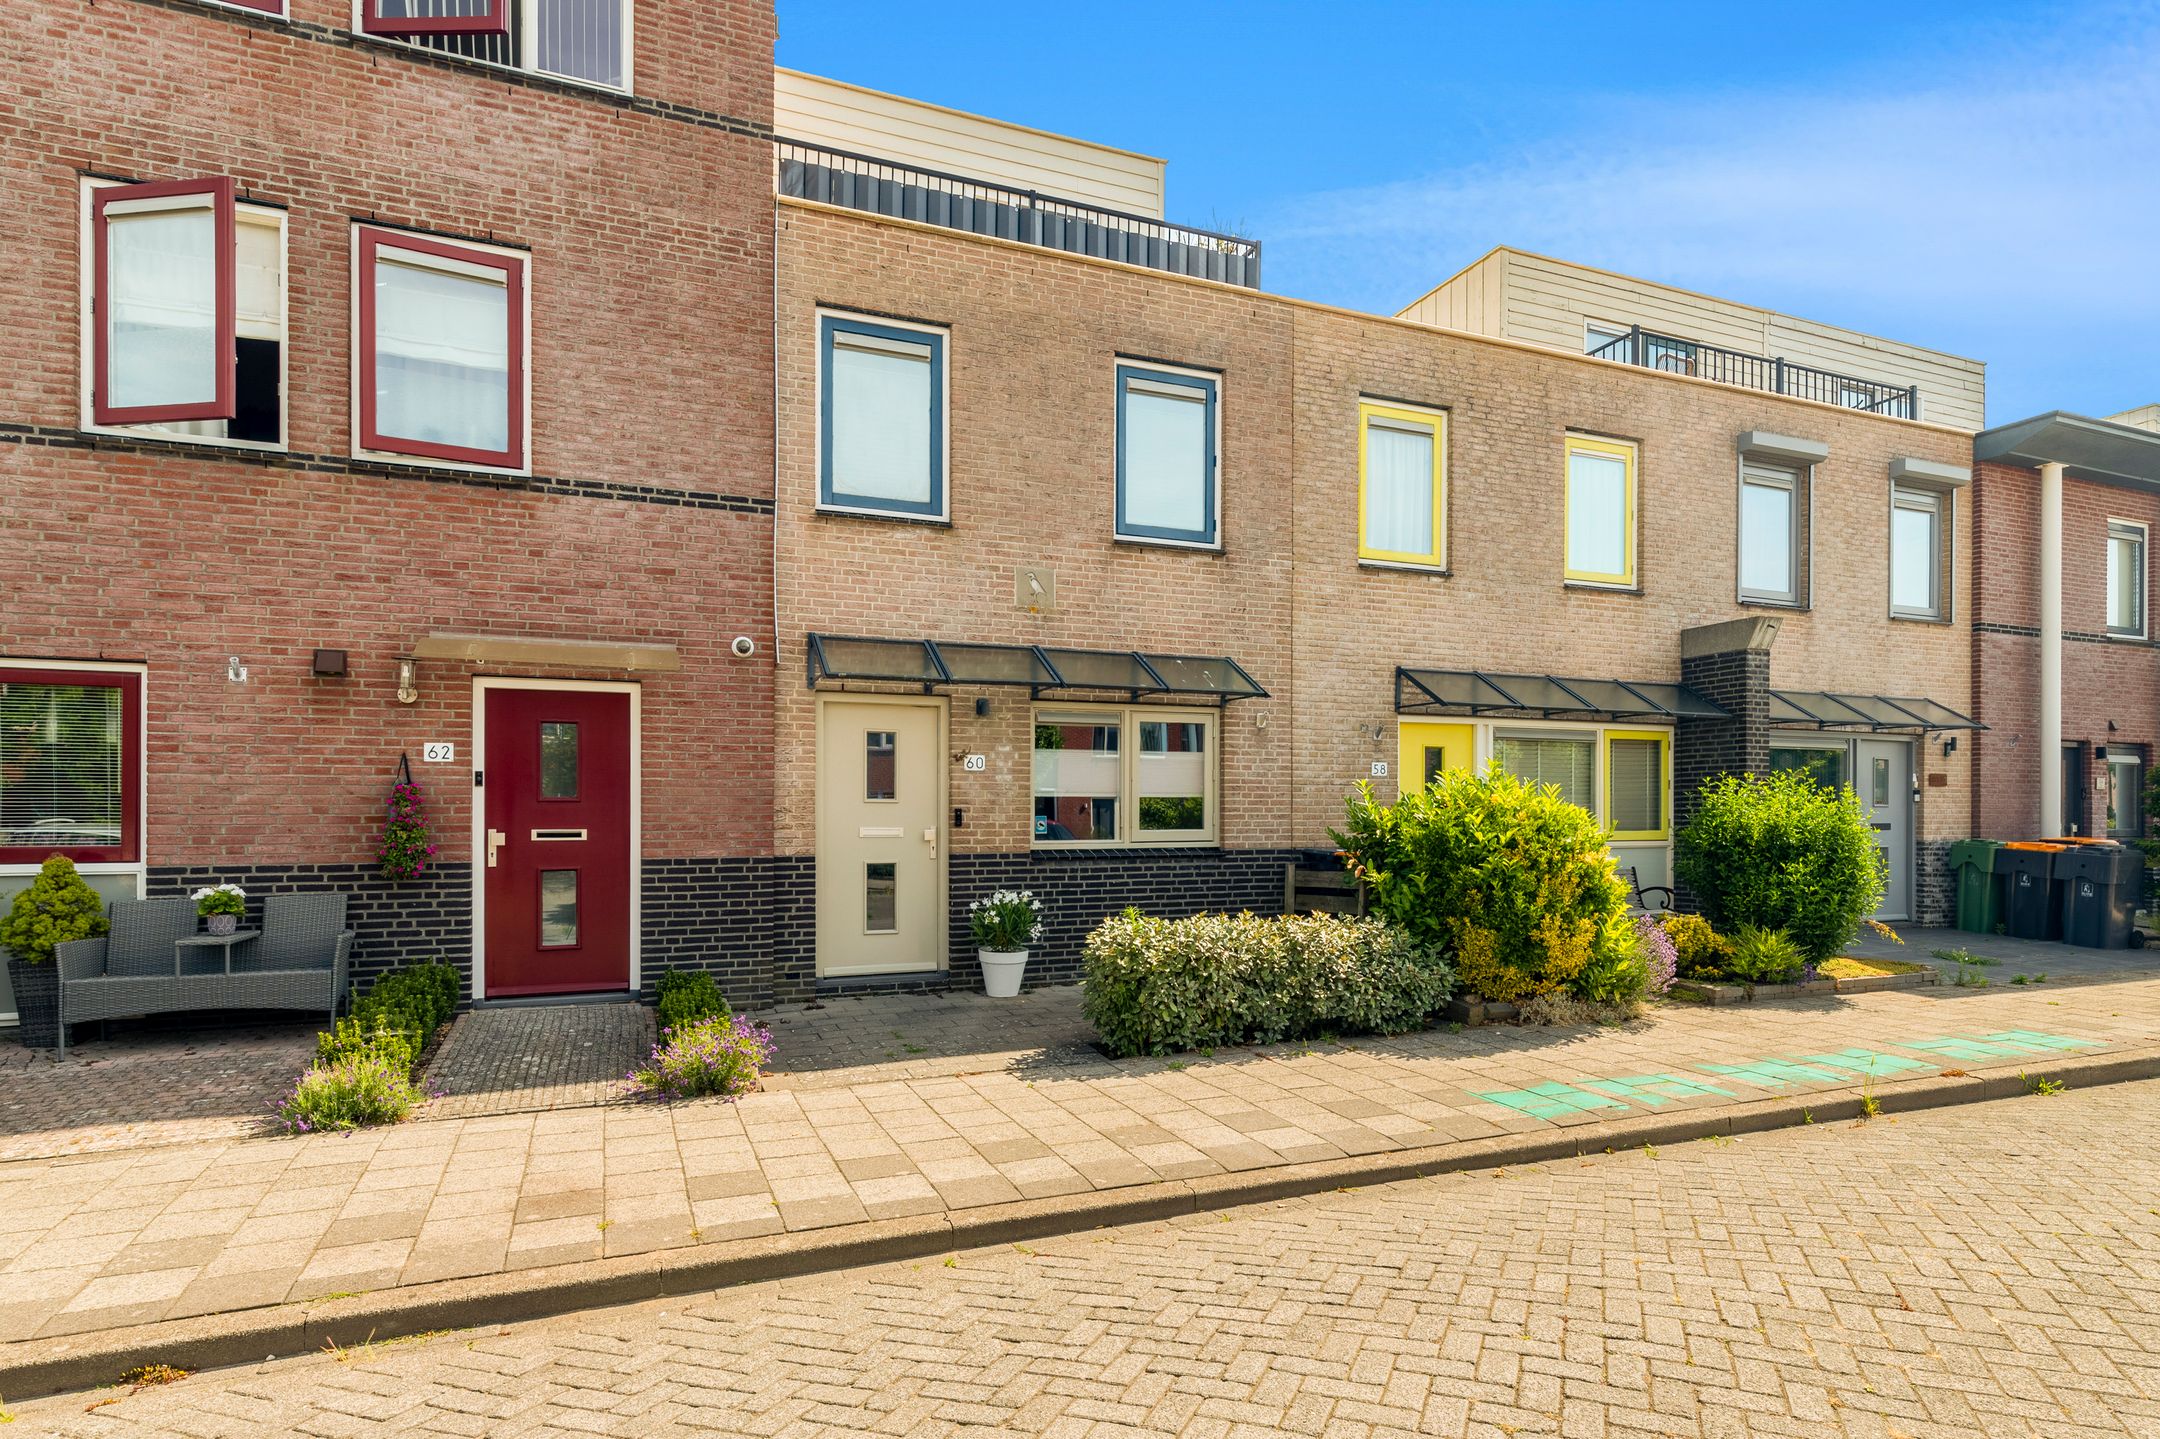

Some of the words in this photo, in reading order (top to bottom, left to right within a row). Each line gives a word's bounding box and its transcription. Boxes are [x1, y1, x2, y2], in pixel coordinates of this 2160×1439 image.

[428, 745, 450, 760] 62
[966, 756, 984, 769] 60
[1373, 763, 1386, 775] 58
